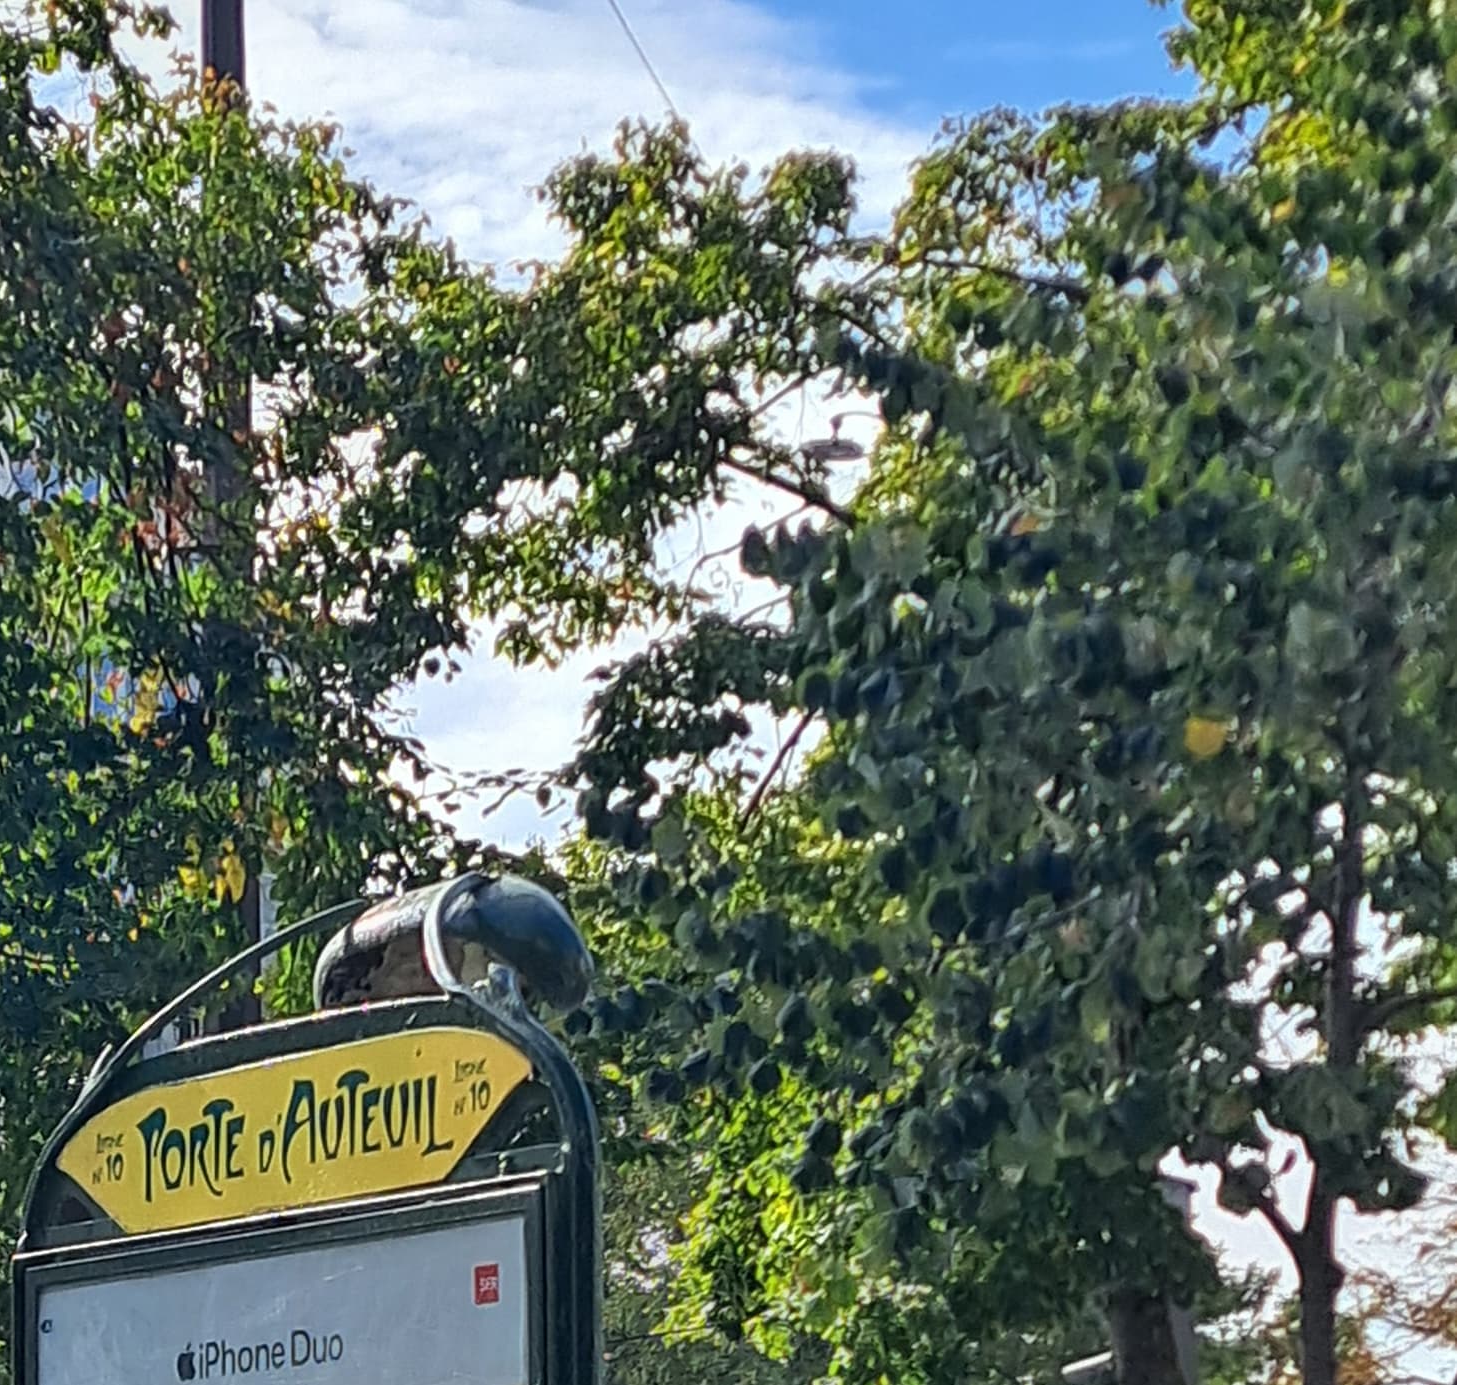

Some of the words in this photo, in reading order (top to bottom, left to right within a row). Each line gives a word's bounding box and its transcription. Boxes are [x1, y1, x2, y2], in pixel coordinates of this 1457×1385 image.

[470, 1080, 490, 1112] 10
[106, 1152, 124, 1182] 10
[136, 1098, 245, 1202] PORTE
[198, 1339, 286, 1379] iPhone
[291, 1329, 343, 1367] Duo
